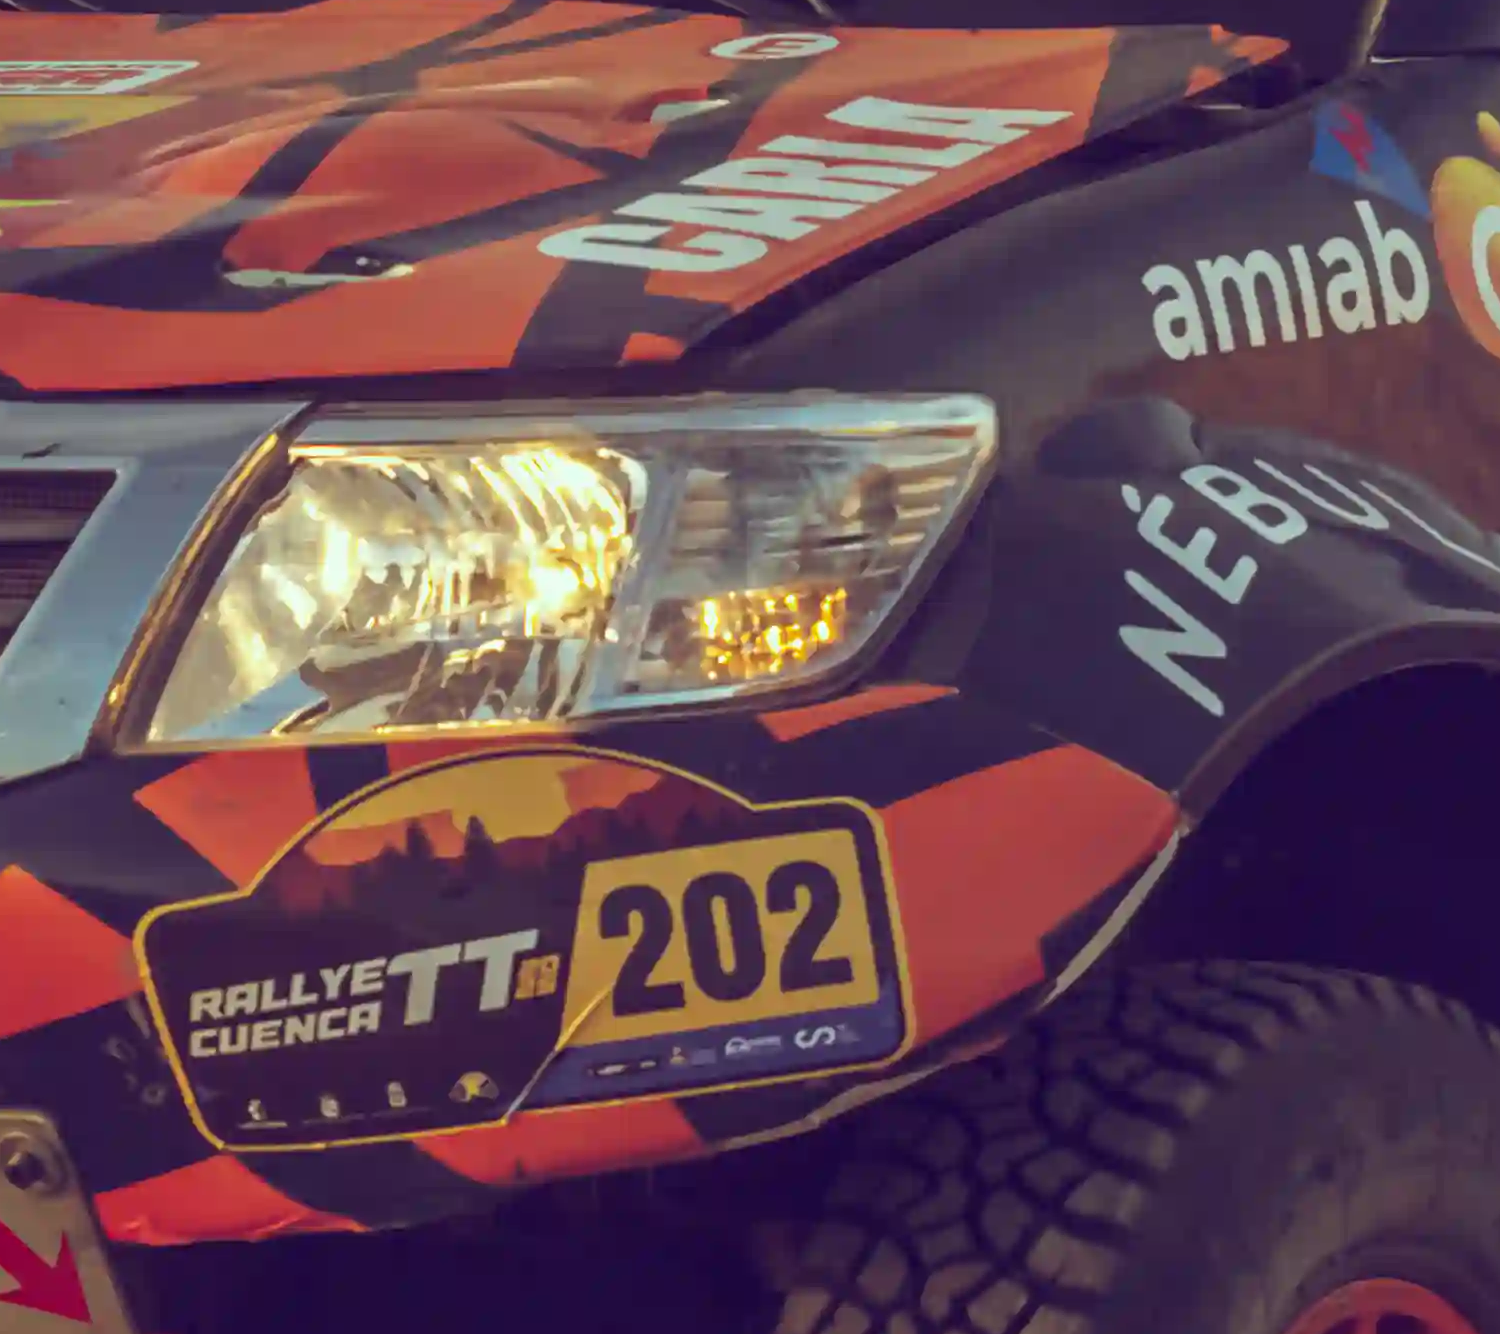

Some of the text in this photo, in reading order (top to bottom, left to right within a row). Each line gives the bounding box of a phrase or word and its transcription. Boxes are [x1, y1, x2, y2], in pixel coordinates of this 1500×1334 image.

[537, 95, 1075, 272] CARLA
[188, 956, 386, 1022] RALLYE
[384, 929, 541, 1027] TT
[600, 860, 857, 1019] 202
[188, 1001, 382, 1059] CUENCA
